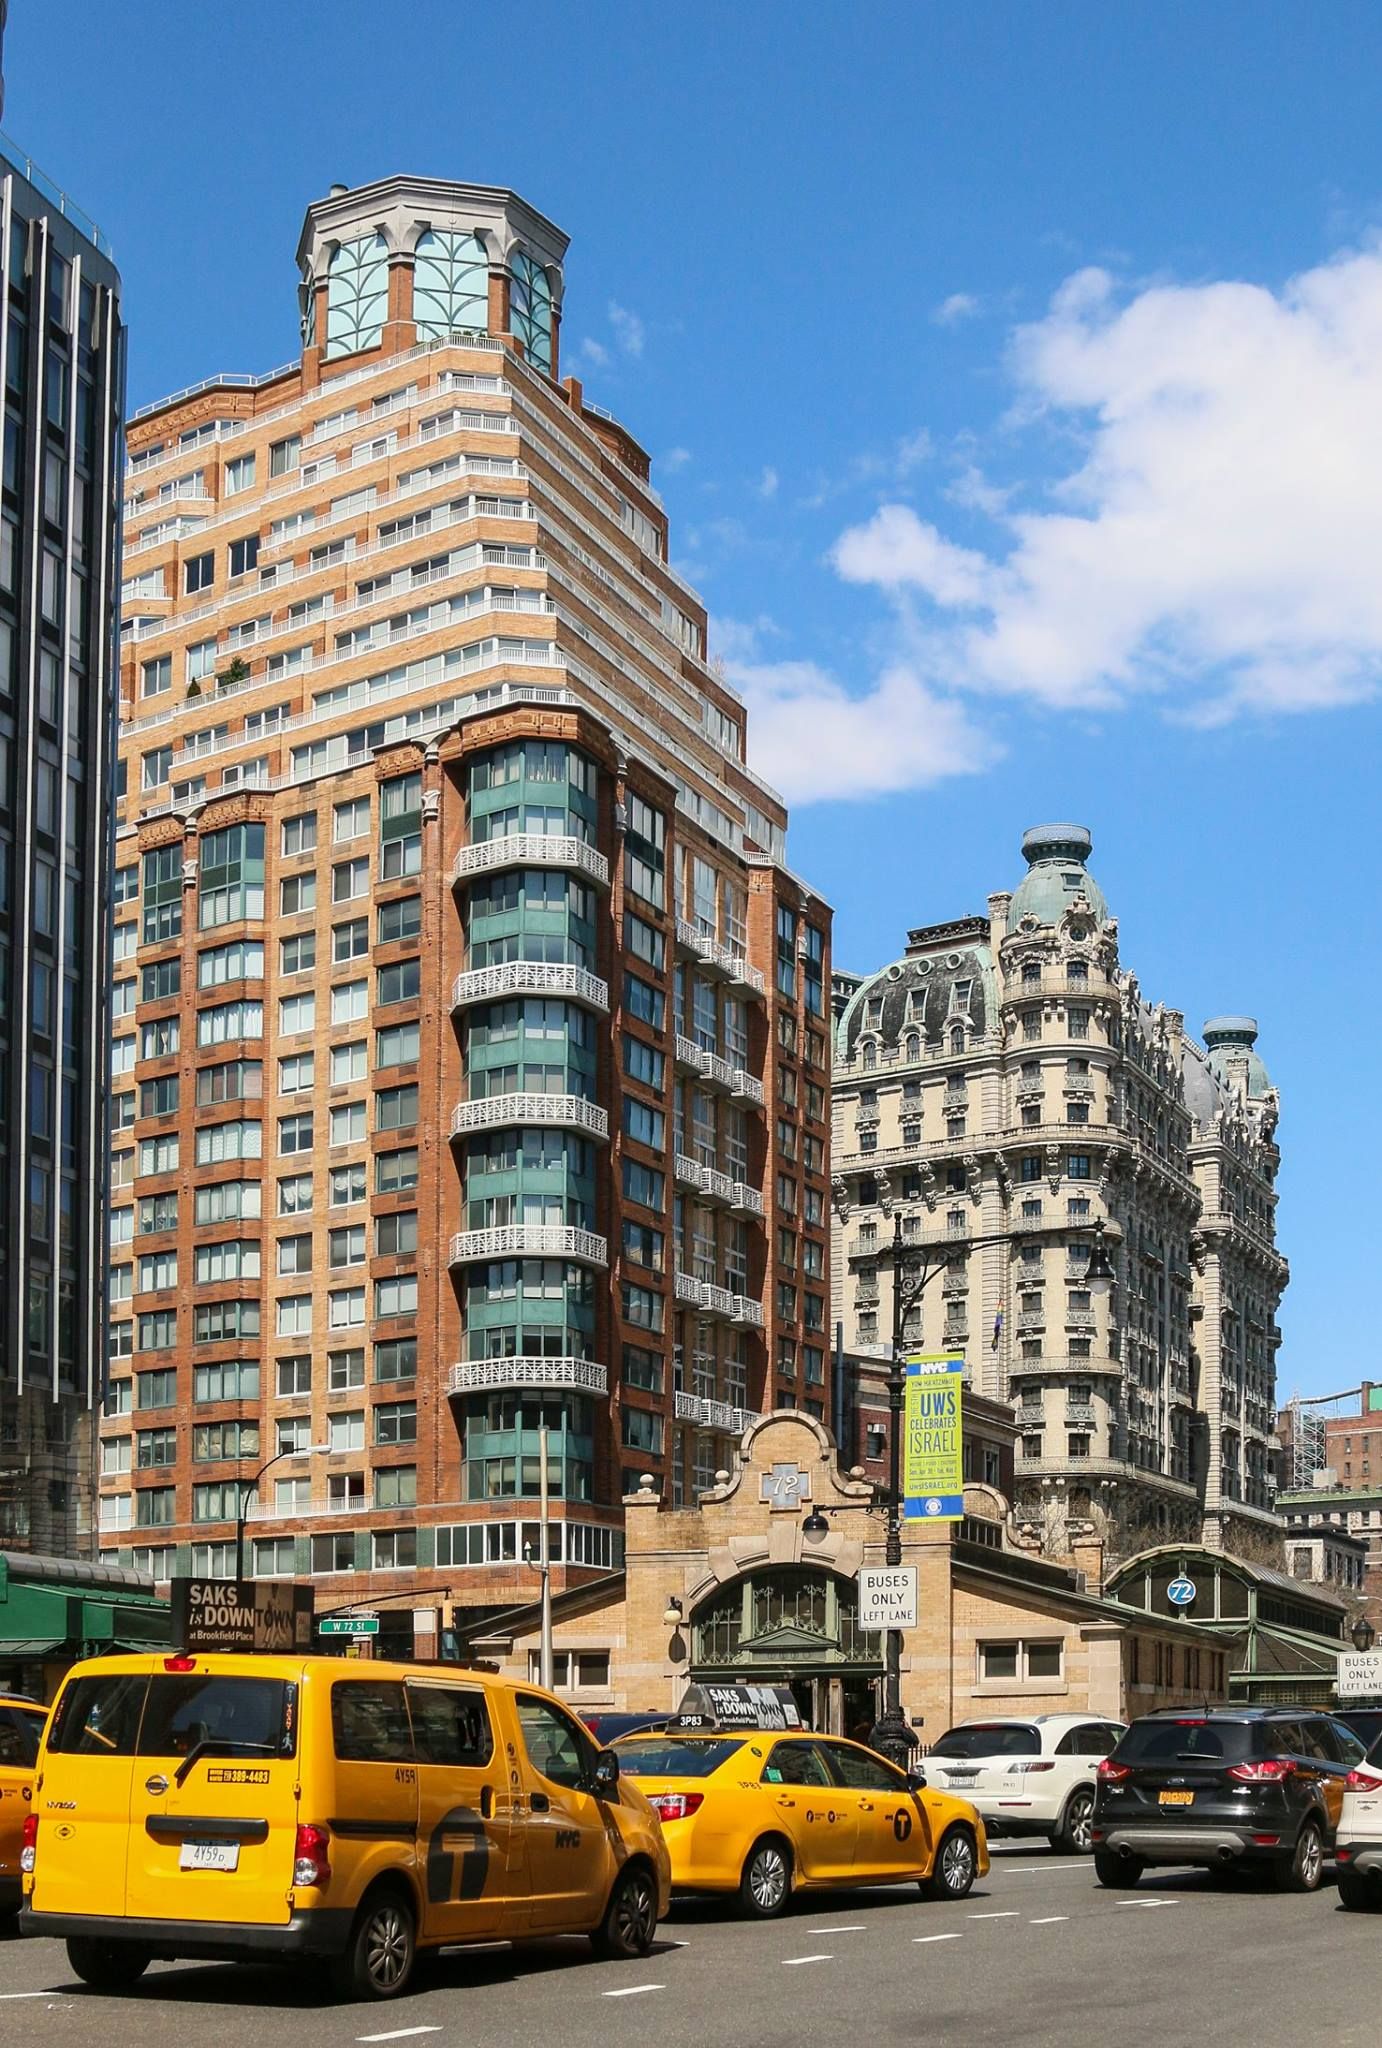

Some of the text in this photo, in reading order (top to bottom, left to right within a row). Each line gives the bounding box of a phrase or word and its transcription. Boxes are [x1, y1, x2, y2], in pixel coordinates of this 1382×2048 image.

[920, 1362, 948, 1375] NYC
[920, 1391, 956, 1418] UWS
[910, 1417, 957, 1430] CELEBRATES
[910, 1430, 957, 1454] ISRAEL
[769, 1475, 800, 1496] 72
[867, 1575, 909, 1588] BUSES
[189, 1584, 238, 1606] SAKS
[1171, 1583, 1192, 1599] 72
[871, 1592, 904, 1605] ONLY
[189, 1607, 202, 1625] is
[204, 1606, 293, 1628] DOWNTOWN
[863, 1610, 913, 1621] LEFT LANE
[333, 1622, 365, 1631] W 72 St
[197, 1630, 235, 1640] Brookfield
[236, 1631, 254, 1640] Place
[1345, 1657, 1380, 1667] BUSES
[1348, 1670, 1376, 1679] ONLY
[1342, 1681, 1382, 1690] LEFT LANE
[709, 1688, 740, 1702] SAKS
[680, 1716, 702, 1726] 3P83
[231, 1770, 269, 1783] 389-4483
[395, 1767, 416, 1784] 4Y59
[555, 1830, 581, 1849] NYC
